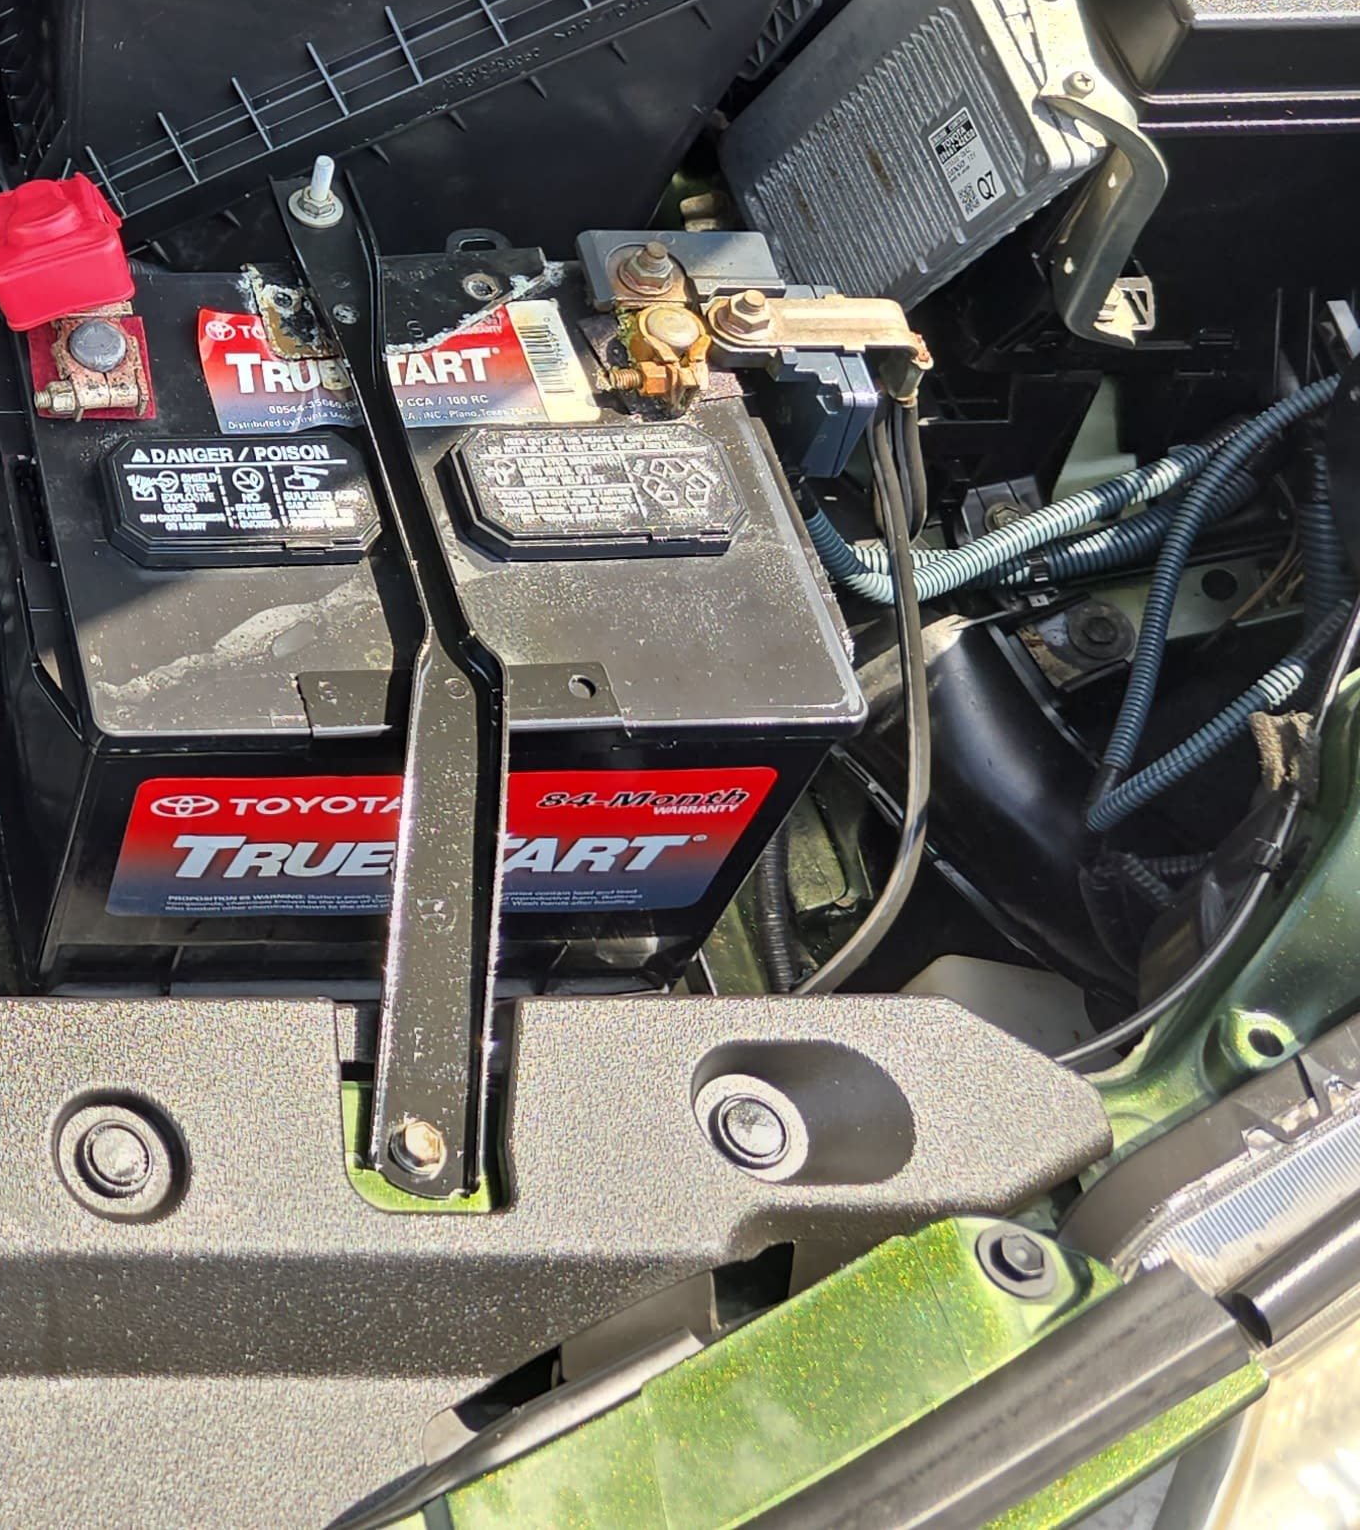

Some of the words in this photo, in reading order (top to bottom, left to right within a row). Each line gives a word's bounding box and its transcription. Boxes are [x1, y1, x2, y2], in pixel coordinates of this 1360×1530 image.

[976, 170, 998, 200] Q7
[406, 397, 434, 407] CCA
[447, 395, 468, 405] 100
[471, 394, 490, 404] RC
[228, 419, 281, 430] Distributed
[151, 448, 234, 463] DANGER
[238, 447, 250, 461] /
[253, 445, 330, 461] POISON
[180, 473, 217, 483] SHIELD
[182, 483, 210, 493] EYES
[161, 492, 216, 503] EXPLOSIVE
[241, 493, 260, 502] NO
[163, 502, 197, 513] GASES
[536, 787, 750, 810] 84-Month
[653, 803, 740, 815] WARRANTY
